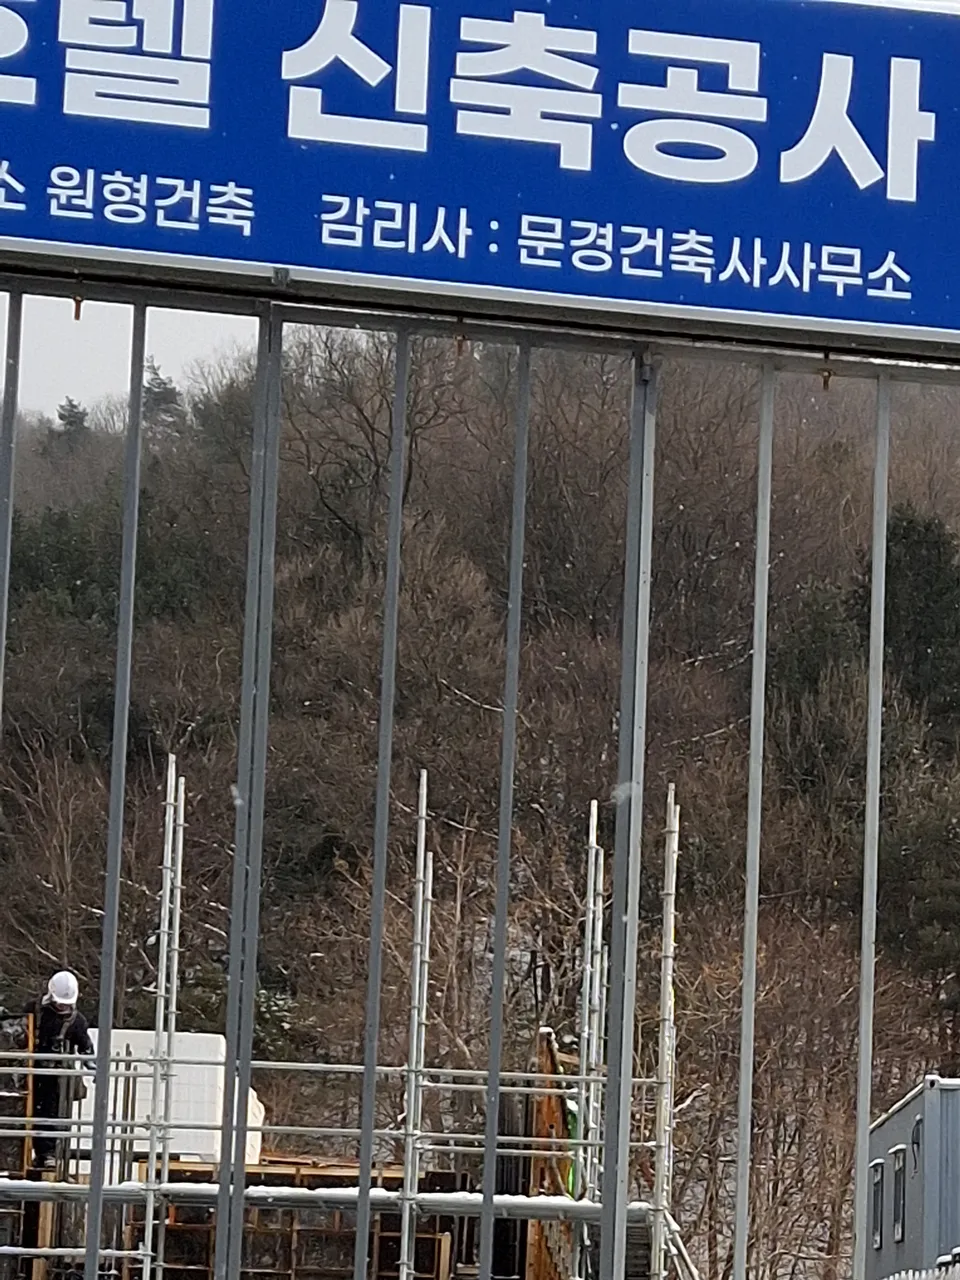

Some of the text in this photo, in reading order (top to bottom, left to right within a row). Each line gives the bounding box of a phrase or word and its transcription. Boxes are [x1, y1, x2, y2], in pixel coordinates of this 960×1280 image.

[0, 0, 936, 203] 텔 신축공사
[46, 165, 255, 237] 원형건축
[320, 194, 473, 259] 감리사
[517, 214, 913, 300] 문경건축사사무소
